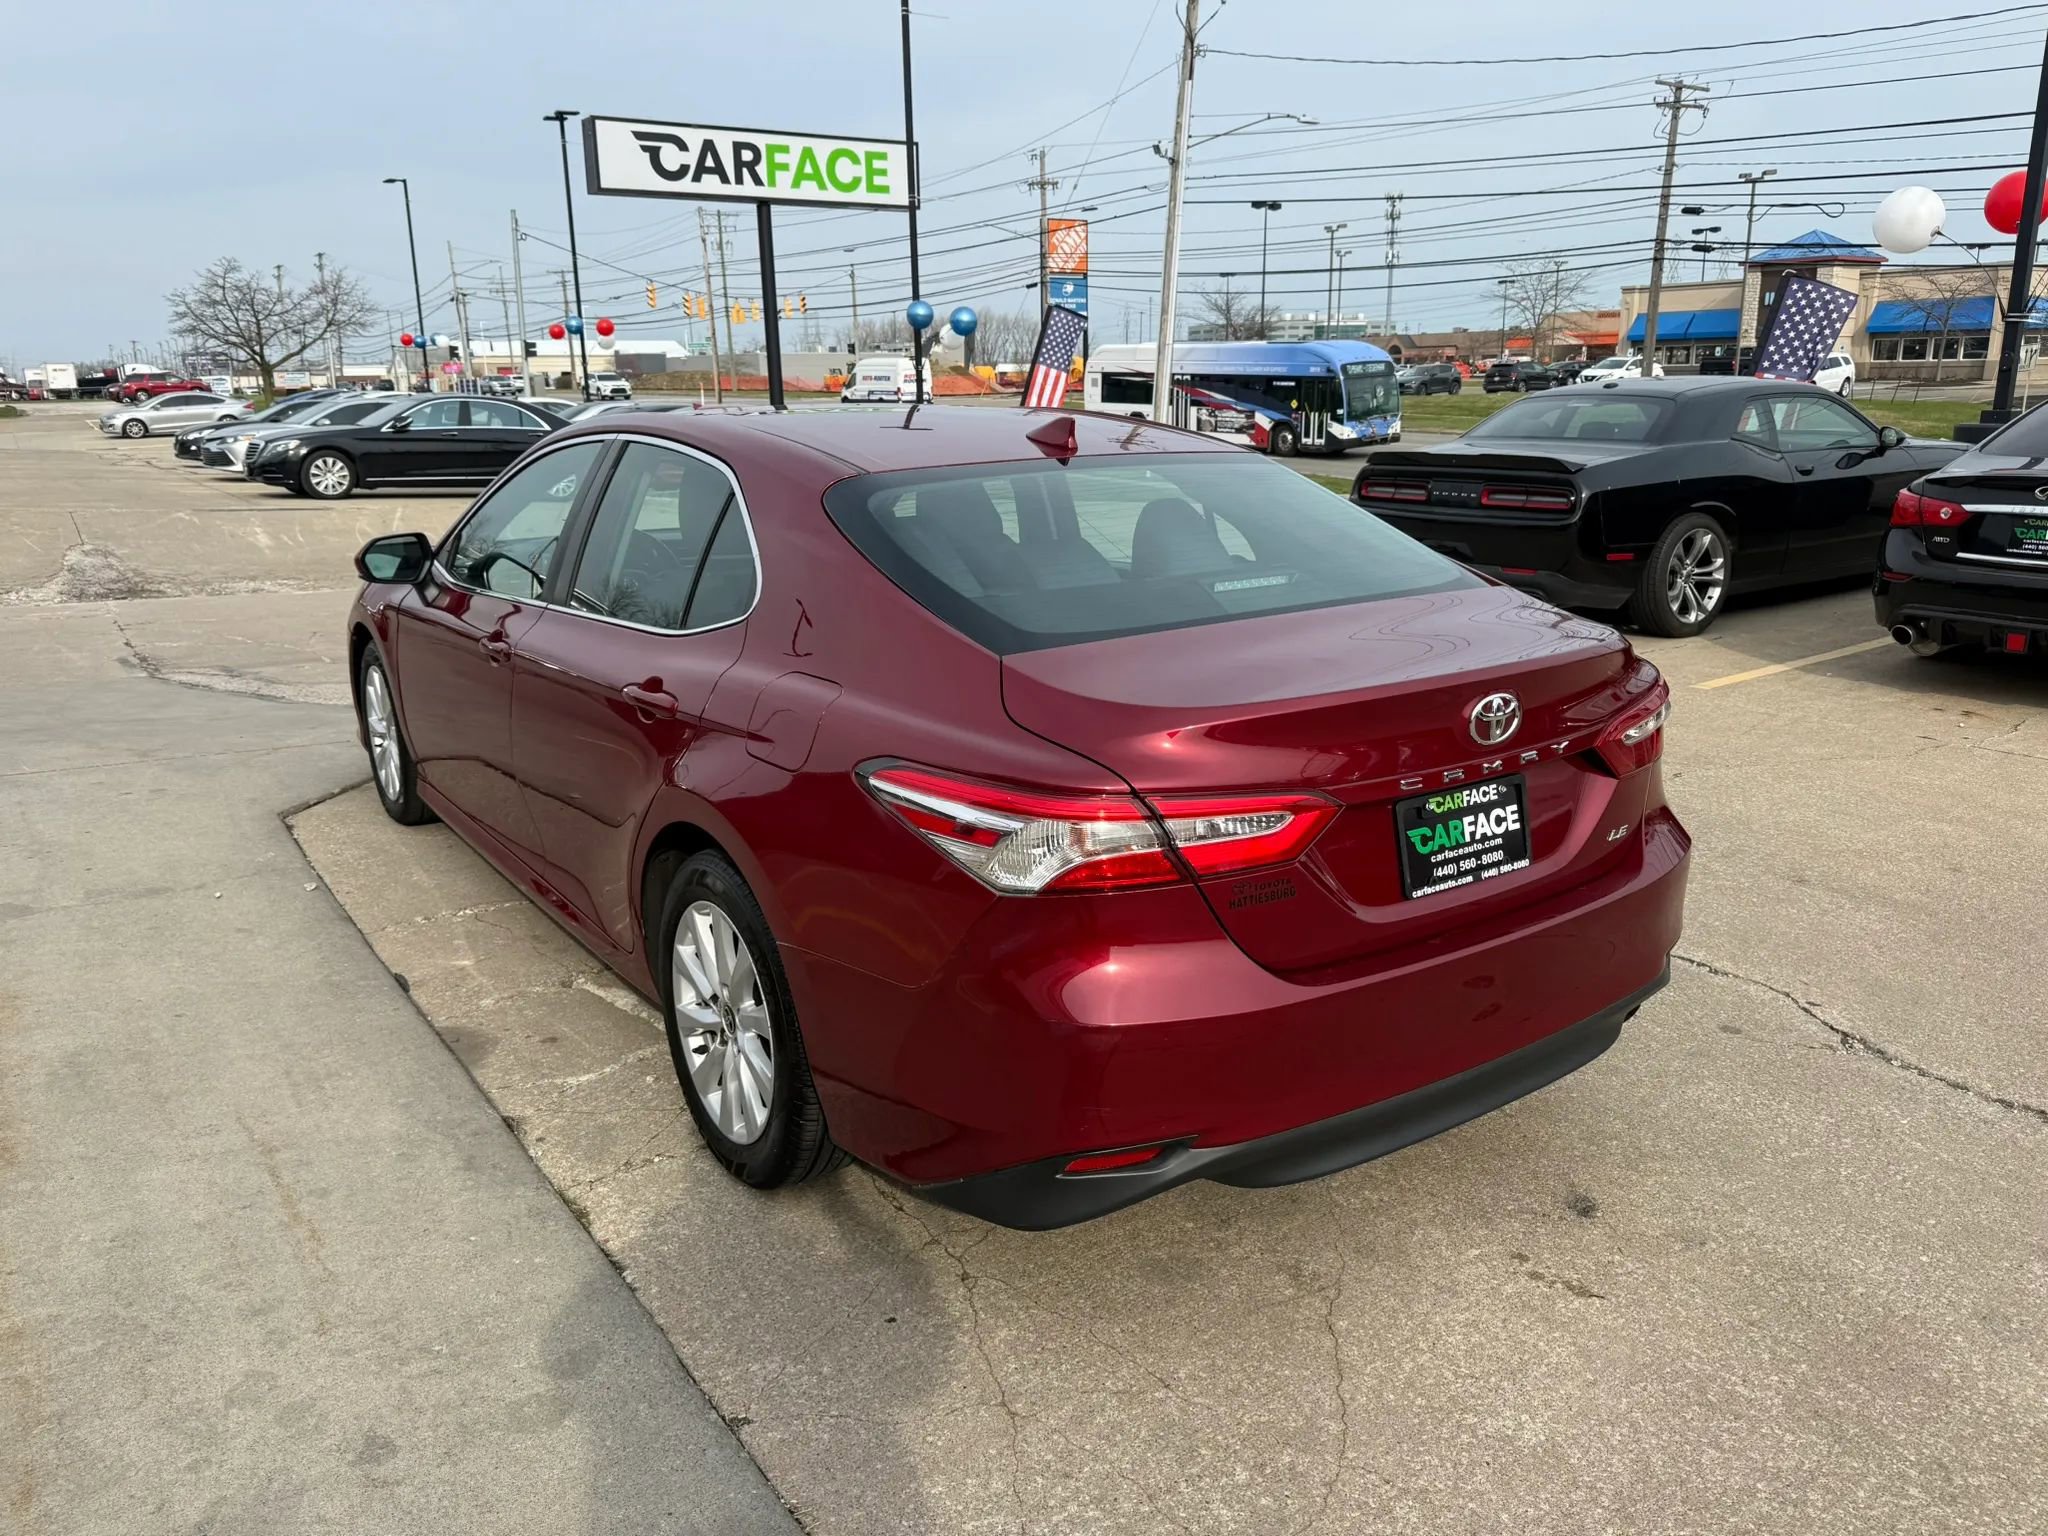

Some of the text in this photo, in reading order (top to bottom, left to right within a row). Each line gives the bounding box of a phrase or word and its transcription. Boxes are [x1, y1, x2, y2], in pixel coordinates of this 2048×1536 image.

[630, 130, 890, 194] CARFACE
[1400, 741, 1569, 790] CAMRY
[1427, 784, 1498, 813] CARFACE
[1407, 804, 1521, 854] CARFACE
[1607, 825, 1629, 841] LE
[1431, 837, 1503, 863] carfaceauto.com
[1412, 875, 1473, 898] carfaceauto.com
[1481, 867, 1498, 880] (440)
[1434, 863, 1457, 877] (440)
[1229, 887, 1297, 910] HATTIESBURG
[1254, 878, 1291, 892] TOYOTA
